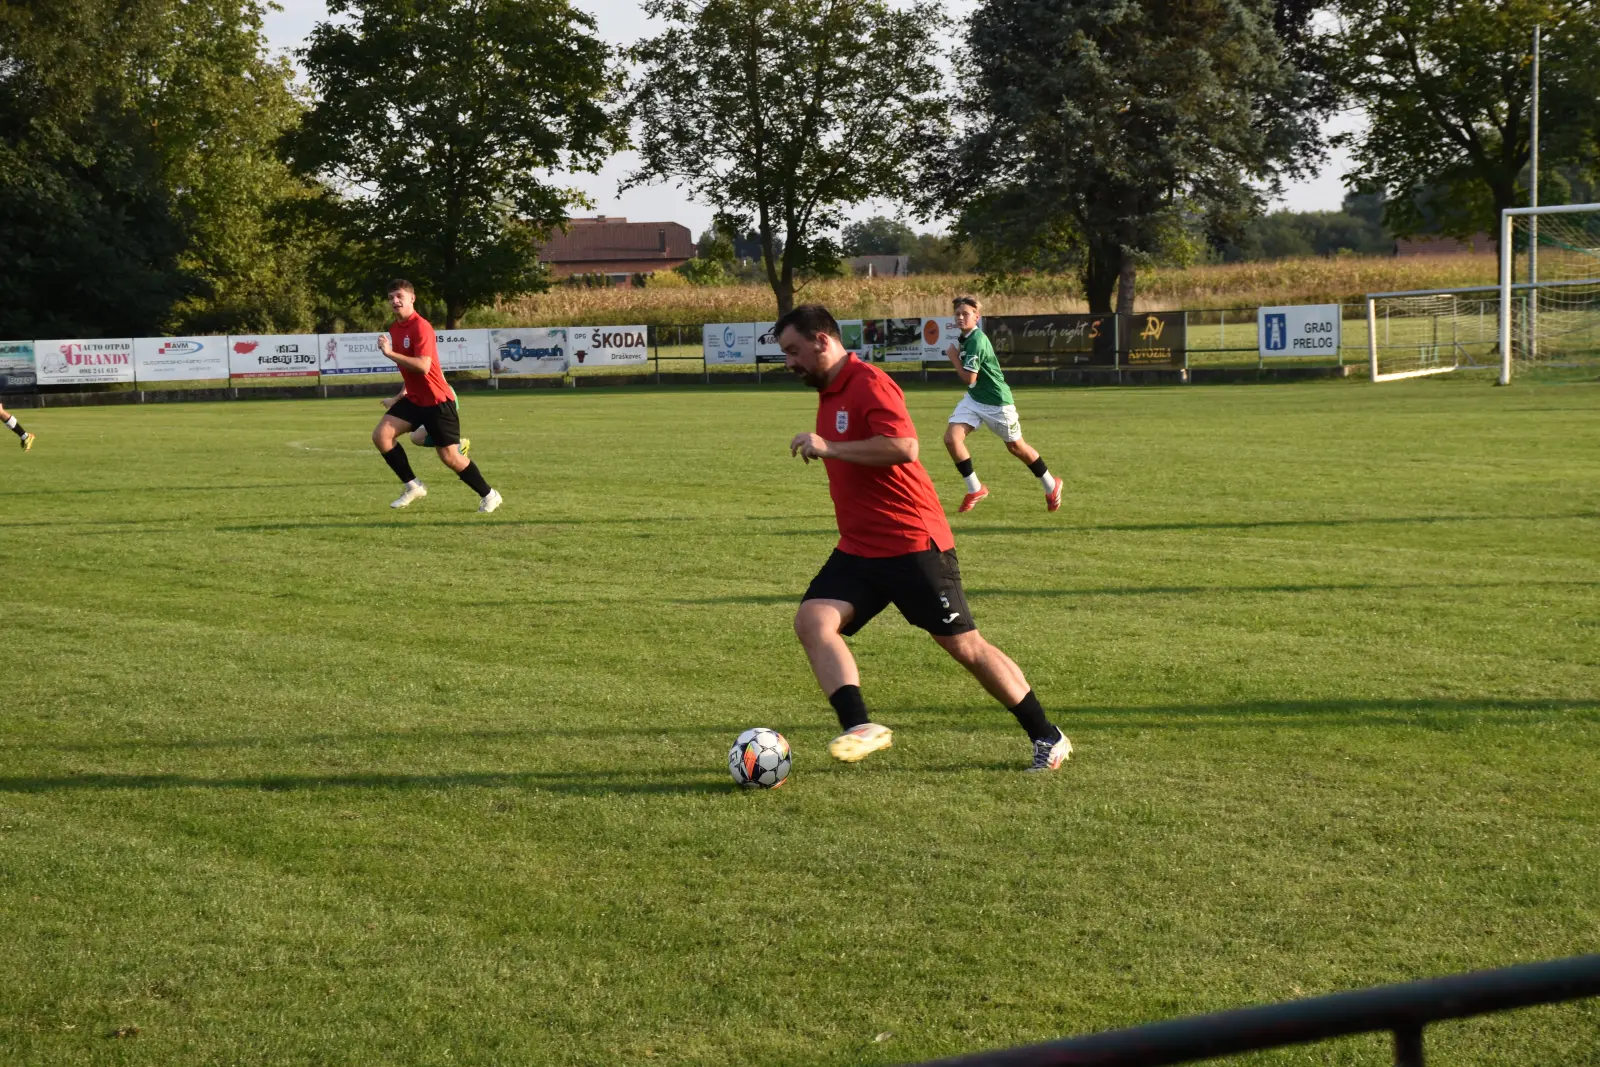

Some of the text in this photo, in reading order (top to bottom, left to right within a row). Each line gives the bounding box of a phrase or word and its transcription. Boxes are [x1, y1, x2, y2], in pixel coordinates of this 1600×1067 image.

[1022, 319, 1058, 348] Twenty
[1060, 320, 1088, 344] eight
[1304, 322, 1333, 333] GRAD
[592, 328, 646, 349] ŠKODA
[1293, 337, 1333, 350] PRELOG
[59, 343, 130, 366] GRANDY
[611, 352, 642, 360] Draškovec
